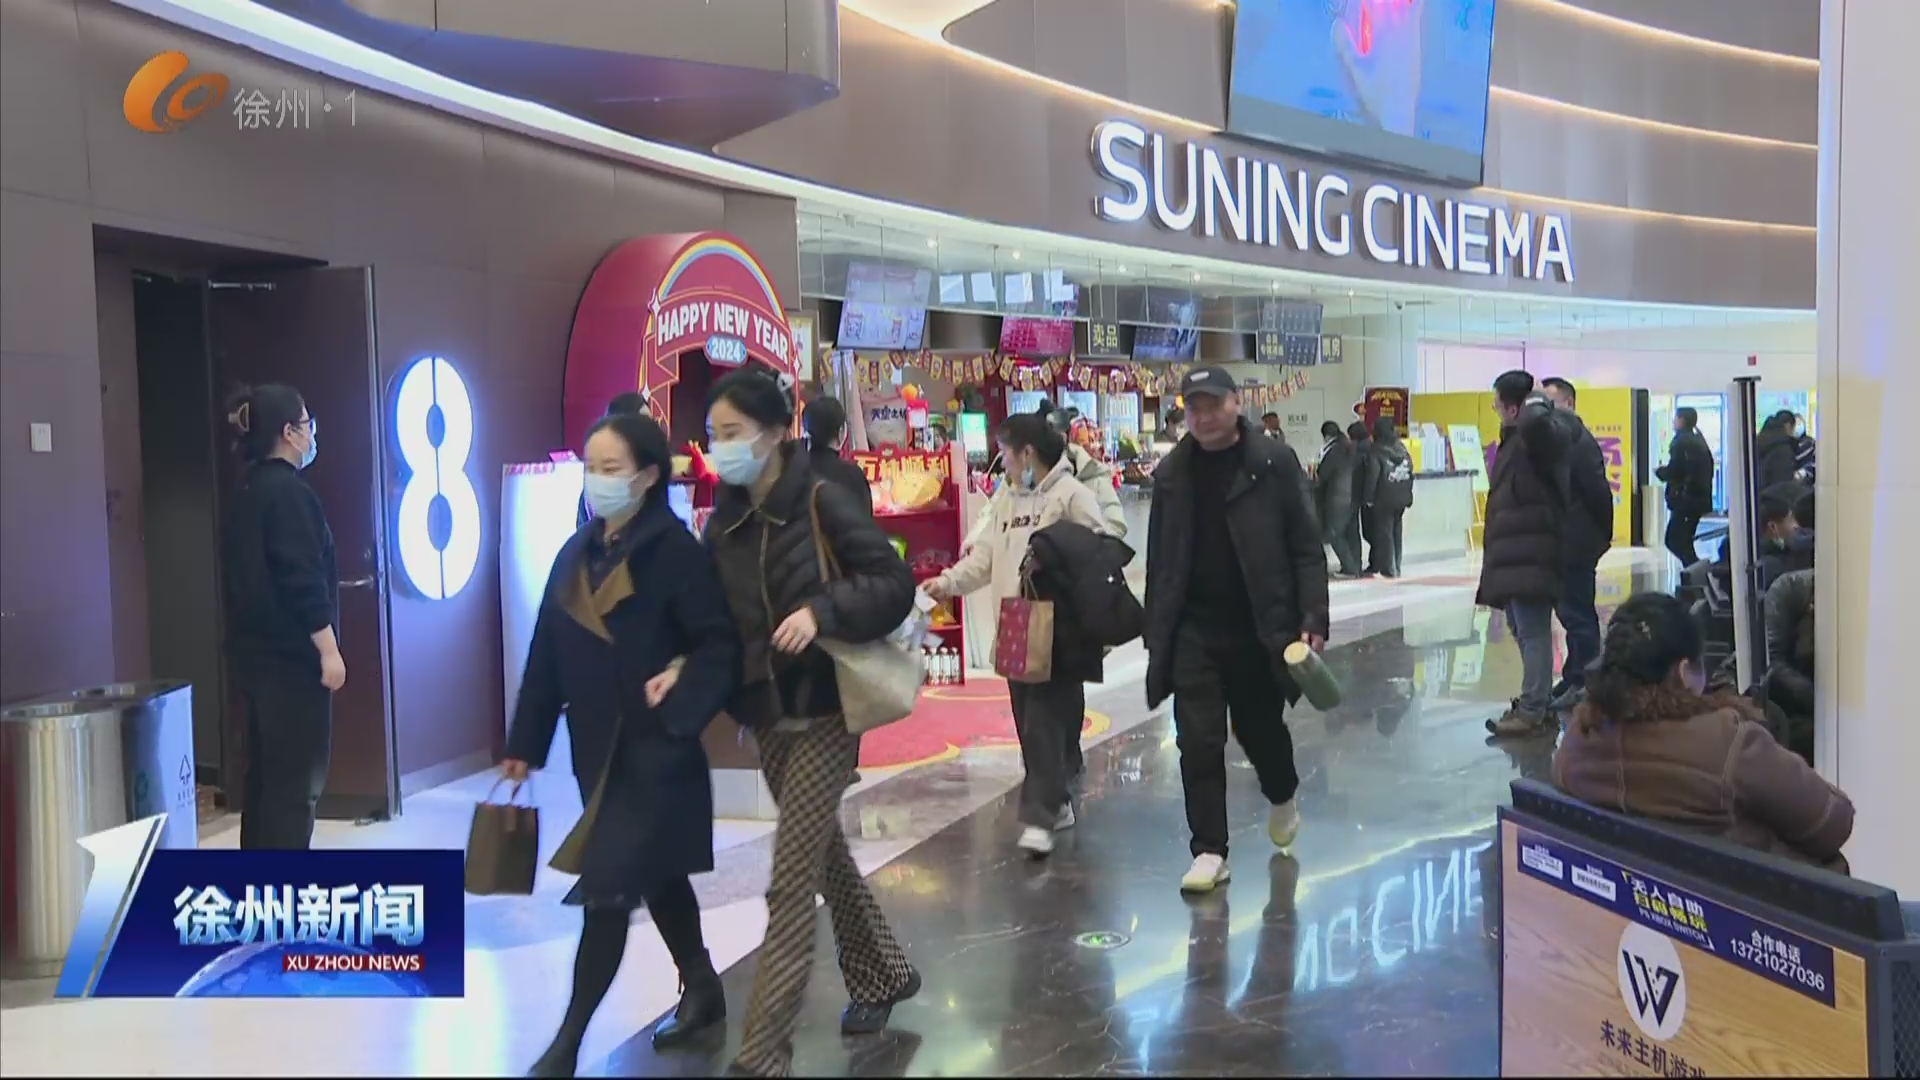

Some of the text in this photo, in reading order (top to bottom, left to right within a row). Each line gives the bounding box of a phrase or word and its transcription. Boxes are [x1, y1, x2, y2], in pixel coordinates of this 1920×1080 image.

[1091, 120, 1576, 283] SUNING CINEMA
[657, 301, 789, 365] HAPPY NEW YEAR
[710, 337, 742, 364] 2024
[1093, 323, 1119, 349] 卖品
[396, 356, 482, 601] 8
[1730, 938, 1826, 992] 13721027036
[1751, 929, 1801, 965] 合作电话
